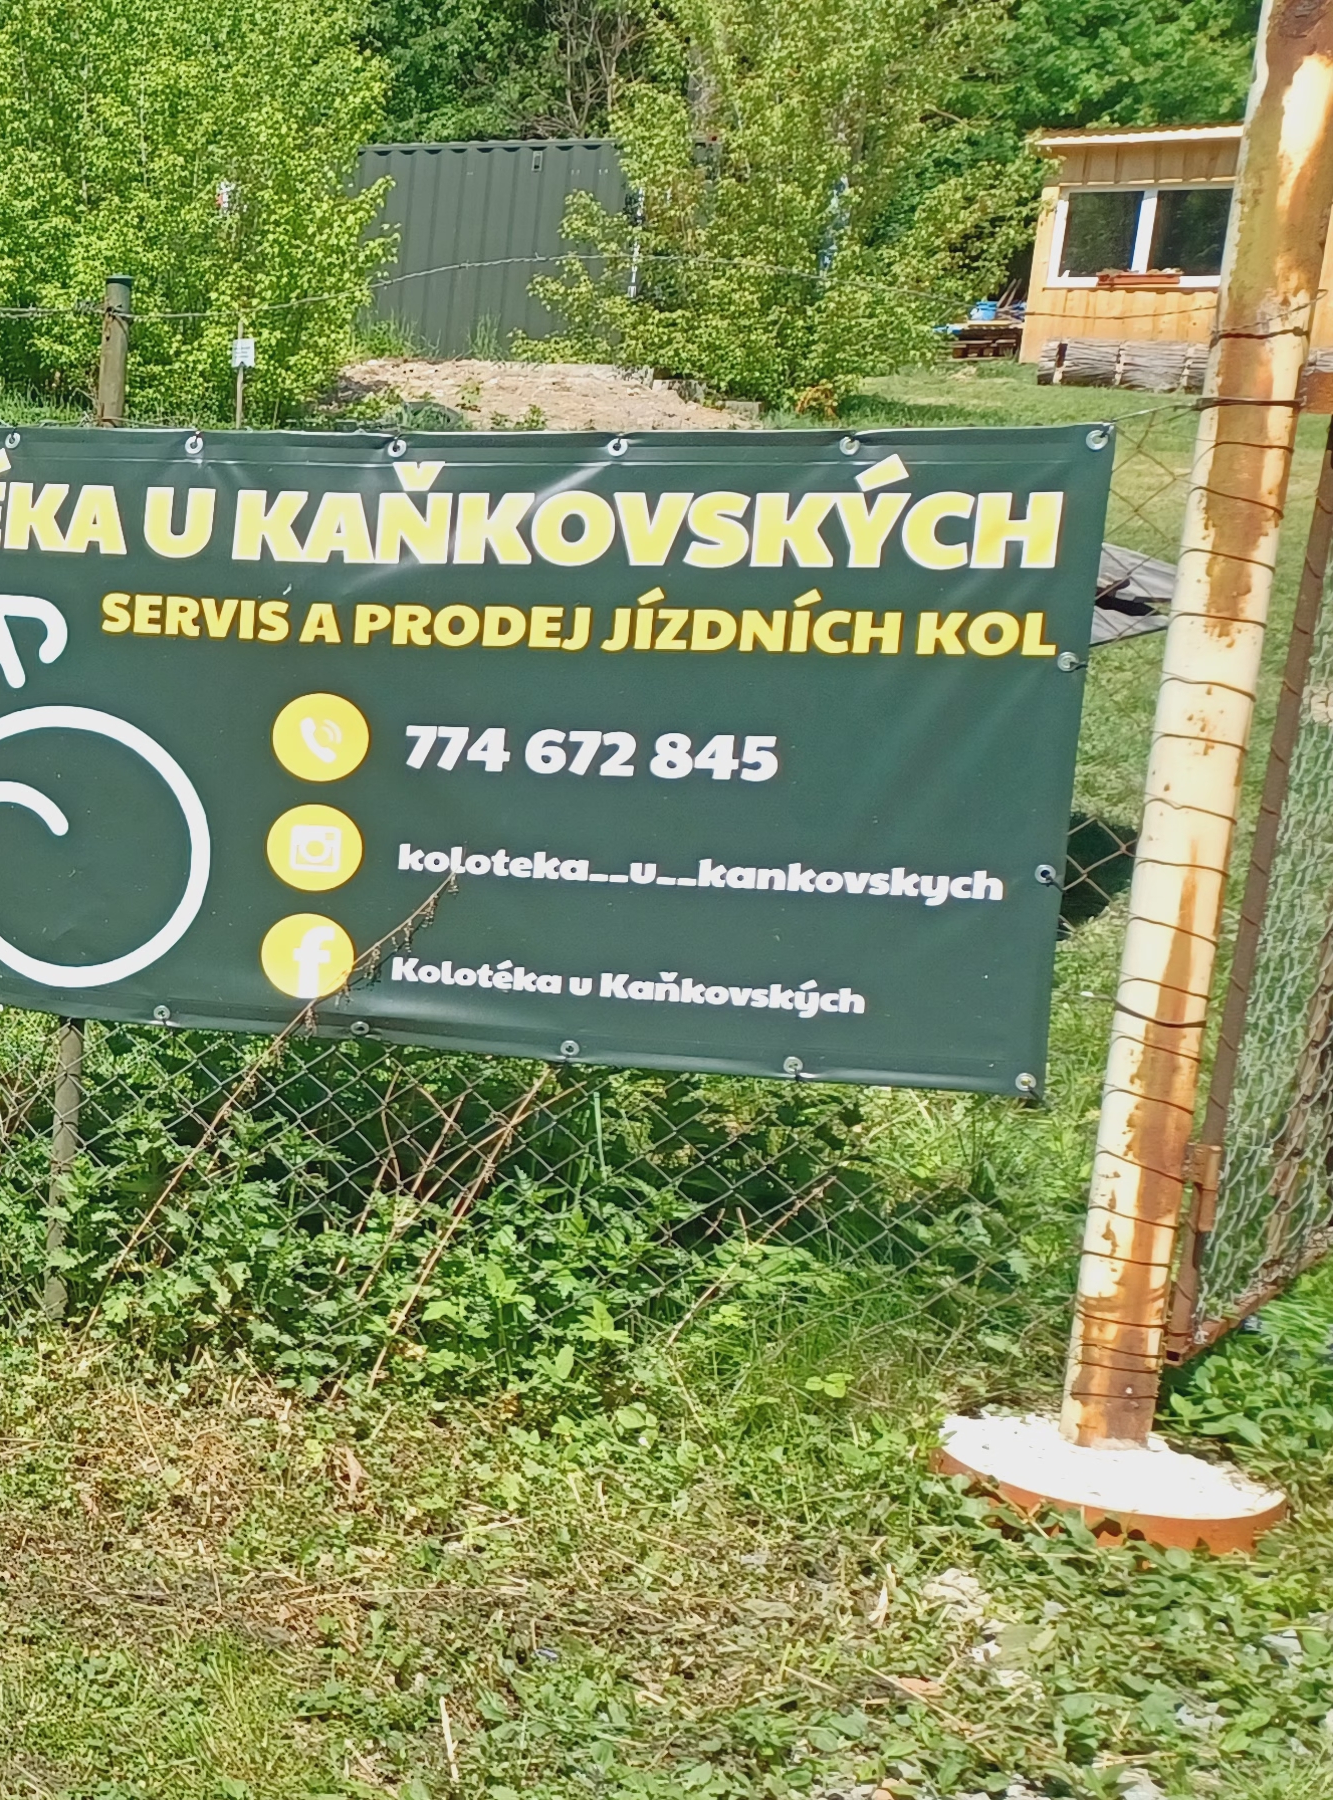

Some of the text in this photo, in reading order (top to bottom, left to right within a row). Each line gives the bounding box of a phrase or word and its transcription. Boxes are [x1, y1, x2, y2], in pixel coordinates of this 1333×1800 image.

[143, 487, 217, 559] U
[231, 454, 1066, 572] KAŇKOVSKÝCH
[100, 587, 1058, 658] SERVIS A PRODEJ JÍZDNÍCH KOL
[404, 724, 779, 782] 774 672 845
[390, 956, 866, 1019] Kolotéka u Kaňkovských
